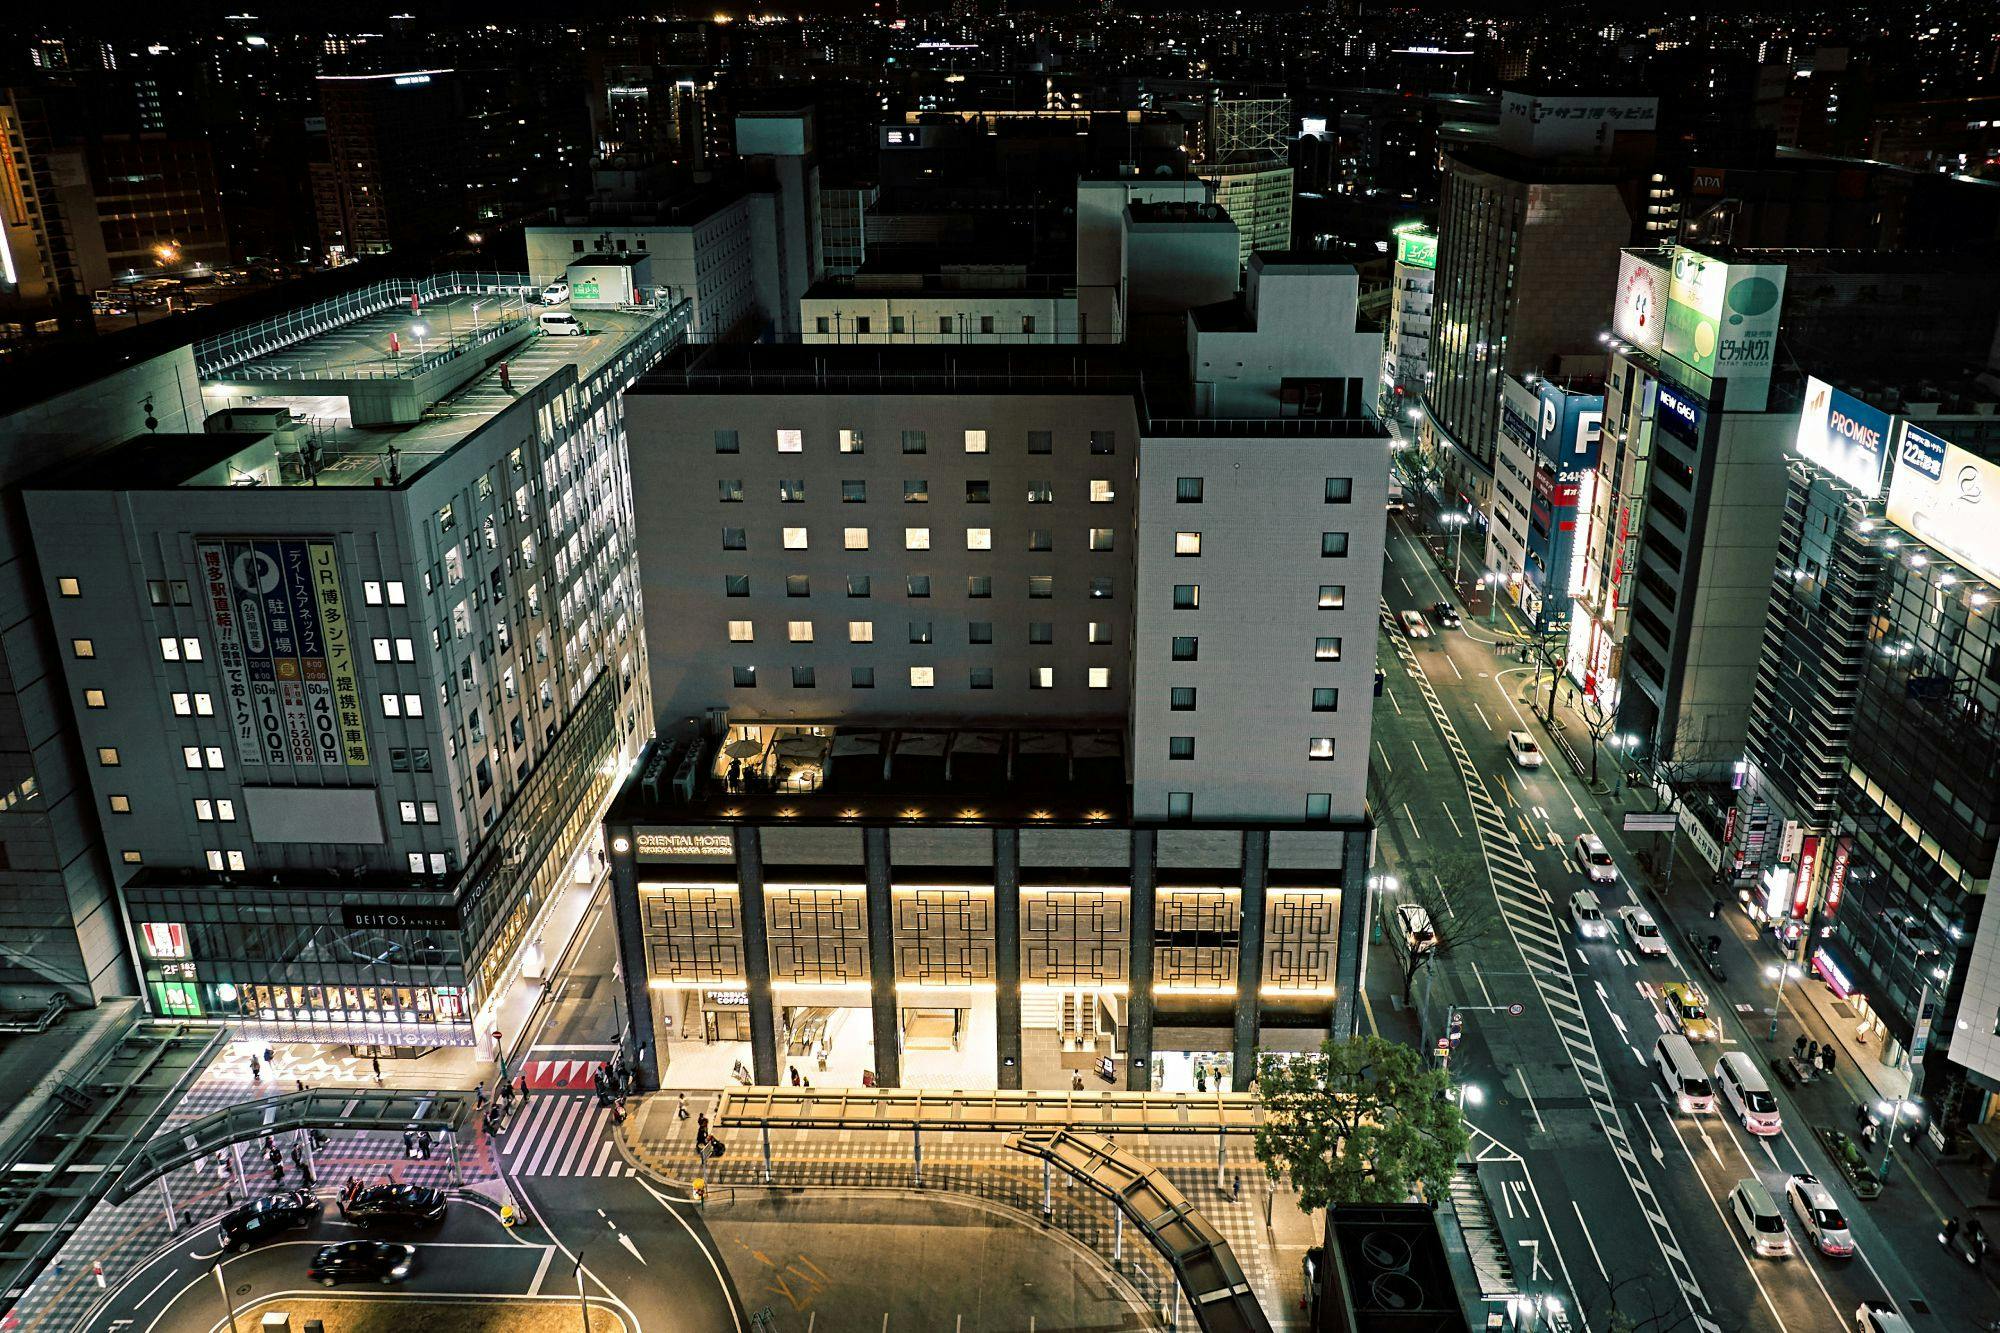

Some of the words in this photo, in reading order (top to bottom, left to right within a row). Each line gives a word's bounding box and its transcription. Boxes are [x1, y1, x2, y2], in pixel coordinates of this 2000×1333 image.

[1695, 176, 1721, 188] APA
[1719, 340, 1769, 360] ピタットハウス
[1660, 390, 1676, 411] NEW
[1541, 397, 1556, 440] P
[1830, 411, 1881, 453] PROMISE
[268, 599, 292, 653] 駐車場
[318, 551, 366, 761] JR博多シティ提携駐車場
[254, 684, 276, 695] 60分
[308, 684, 329, 695] 60分
[262, 697, 284, 762] 100円
[314, 697, 337, 762] 400円
[637, 835, 693, 846] ORIENTAL
[694, 836, 732, 846] HOTEL
[463, 883, 486, 917] DEITOS
[356, 915, 406, 926] DEITOS
[163, 965, 179, 975] 2F
[368, 1033, 427, 1046] DEITOS
[430, 1038, 475, 1046] ANNEX
